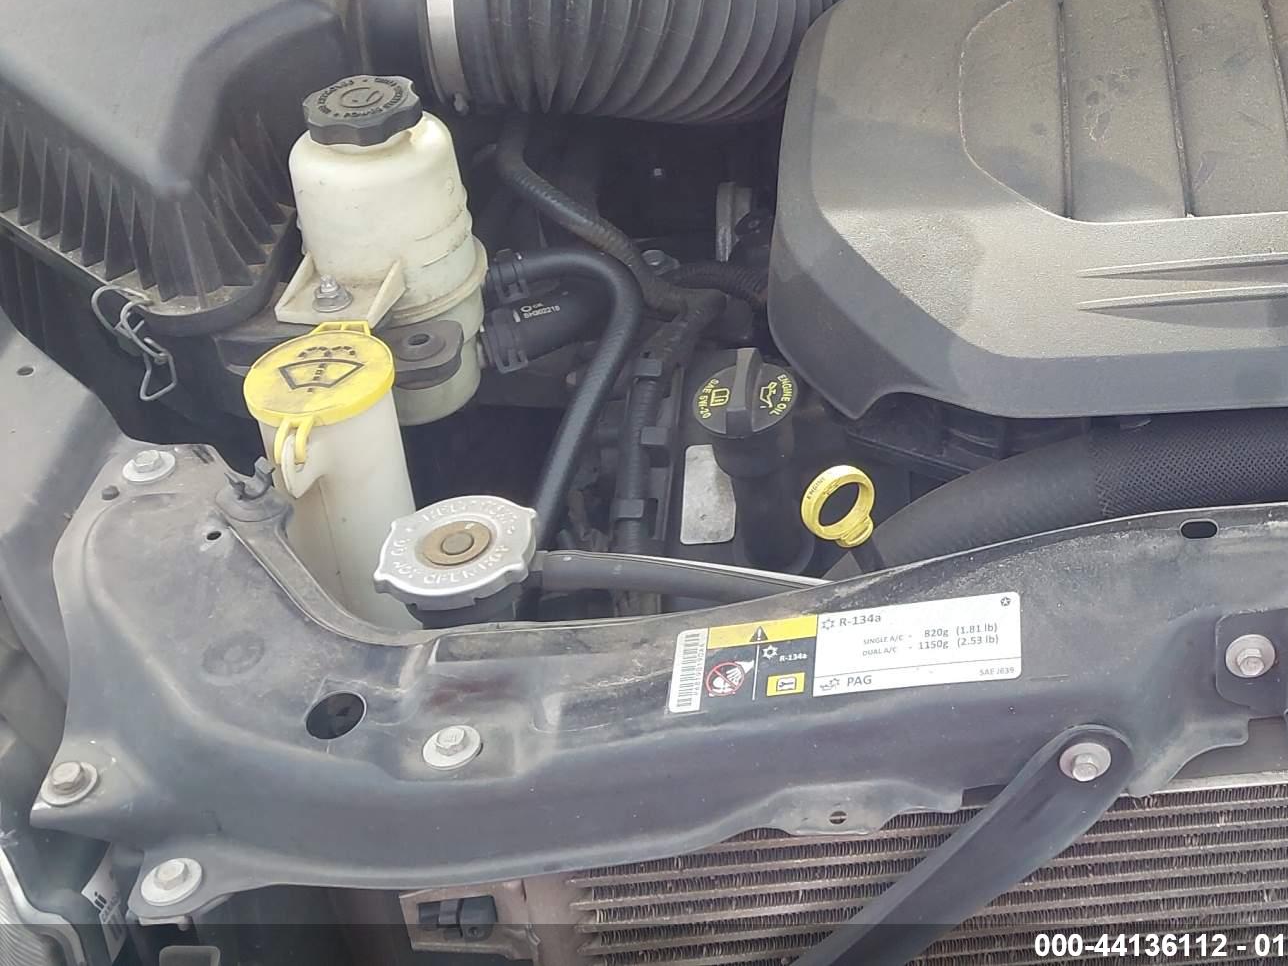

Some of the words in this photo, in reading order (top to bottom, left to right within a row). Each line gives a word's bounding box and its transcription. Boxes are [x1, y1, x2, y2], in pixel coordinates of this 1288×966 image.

[702, 378, 719, 394] SAE
[777, 374, 793, 402] ENGINE
[698, 395, 712, 419] 5W-20
[769, 403, 787, 415] OIL
[839, 614, 882, 627] R-134a
[863, 635, 889, 646] SINGLE
[889, 634, 904, 643] A/C
[924, 628, 949, 638] 820g
[956, 624, 982, 636] (1.81
[983, 622, 998, 634] lb)
[862, 647, 882, 657] DUAL
[883, 646, 897, 655] A/C
[918, 640, 949, 651] 1150g
[957, 636, 983, 648] (2.53
[985, 634, 999, 646] lb)
[779, 653, 808, 663] R-134a
[847, 675, 872, 687] PAG
